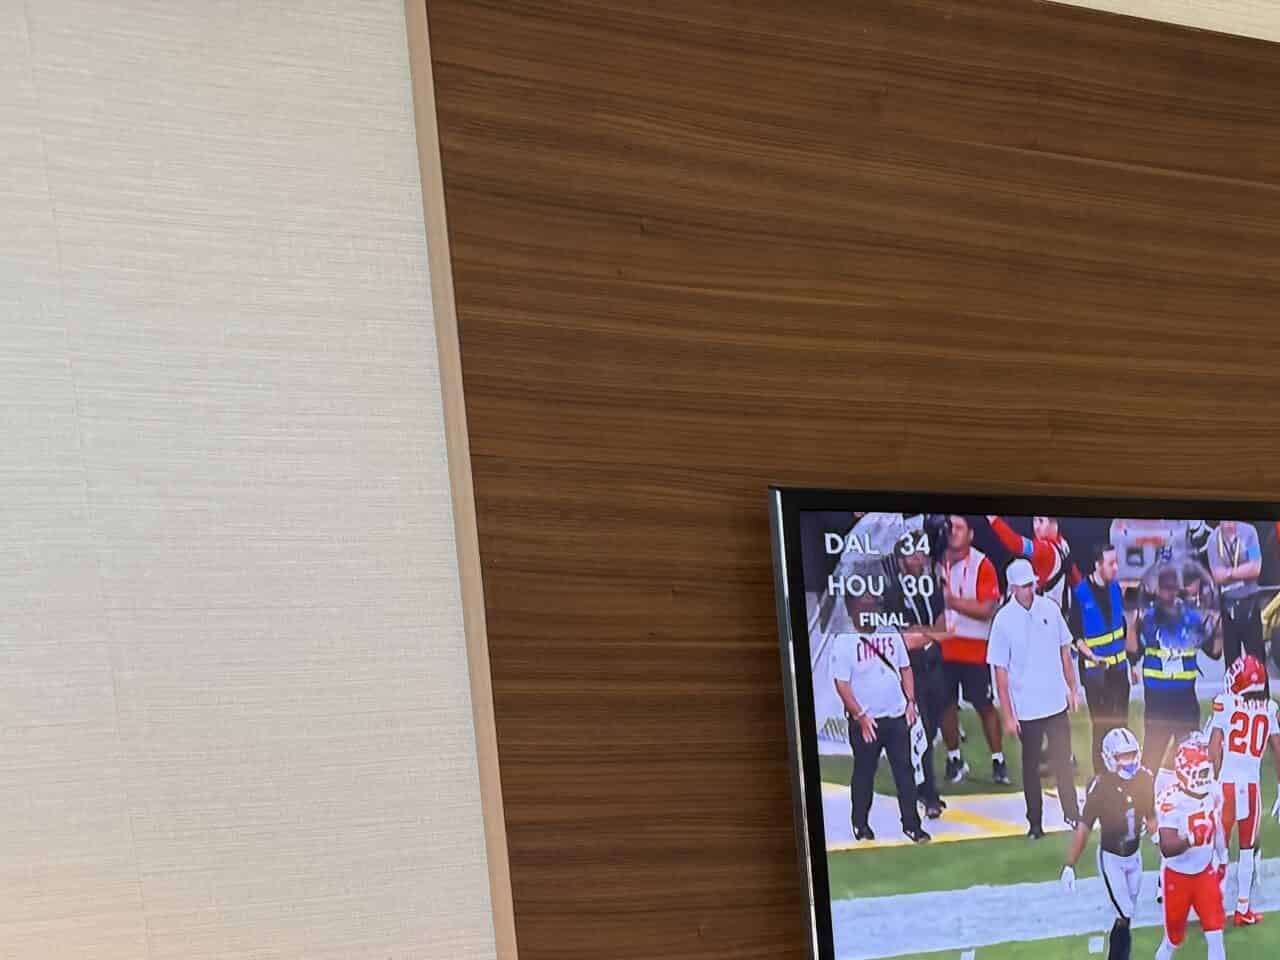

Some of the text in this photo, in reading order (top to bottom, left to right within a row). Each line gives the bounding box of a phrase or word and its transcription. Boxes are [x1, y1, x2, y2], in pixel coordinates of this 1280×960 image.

[824, 532, 931, 555] DAL 34
[827, 574, 935, 597] HOU 30
[859, 612, 909, 627] FINAL
[1228, 711, 1270, 758] 20
